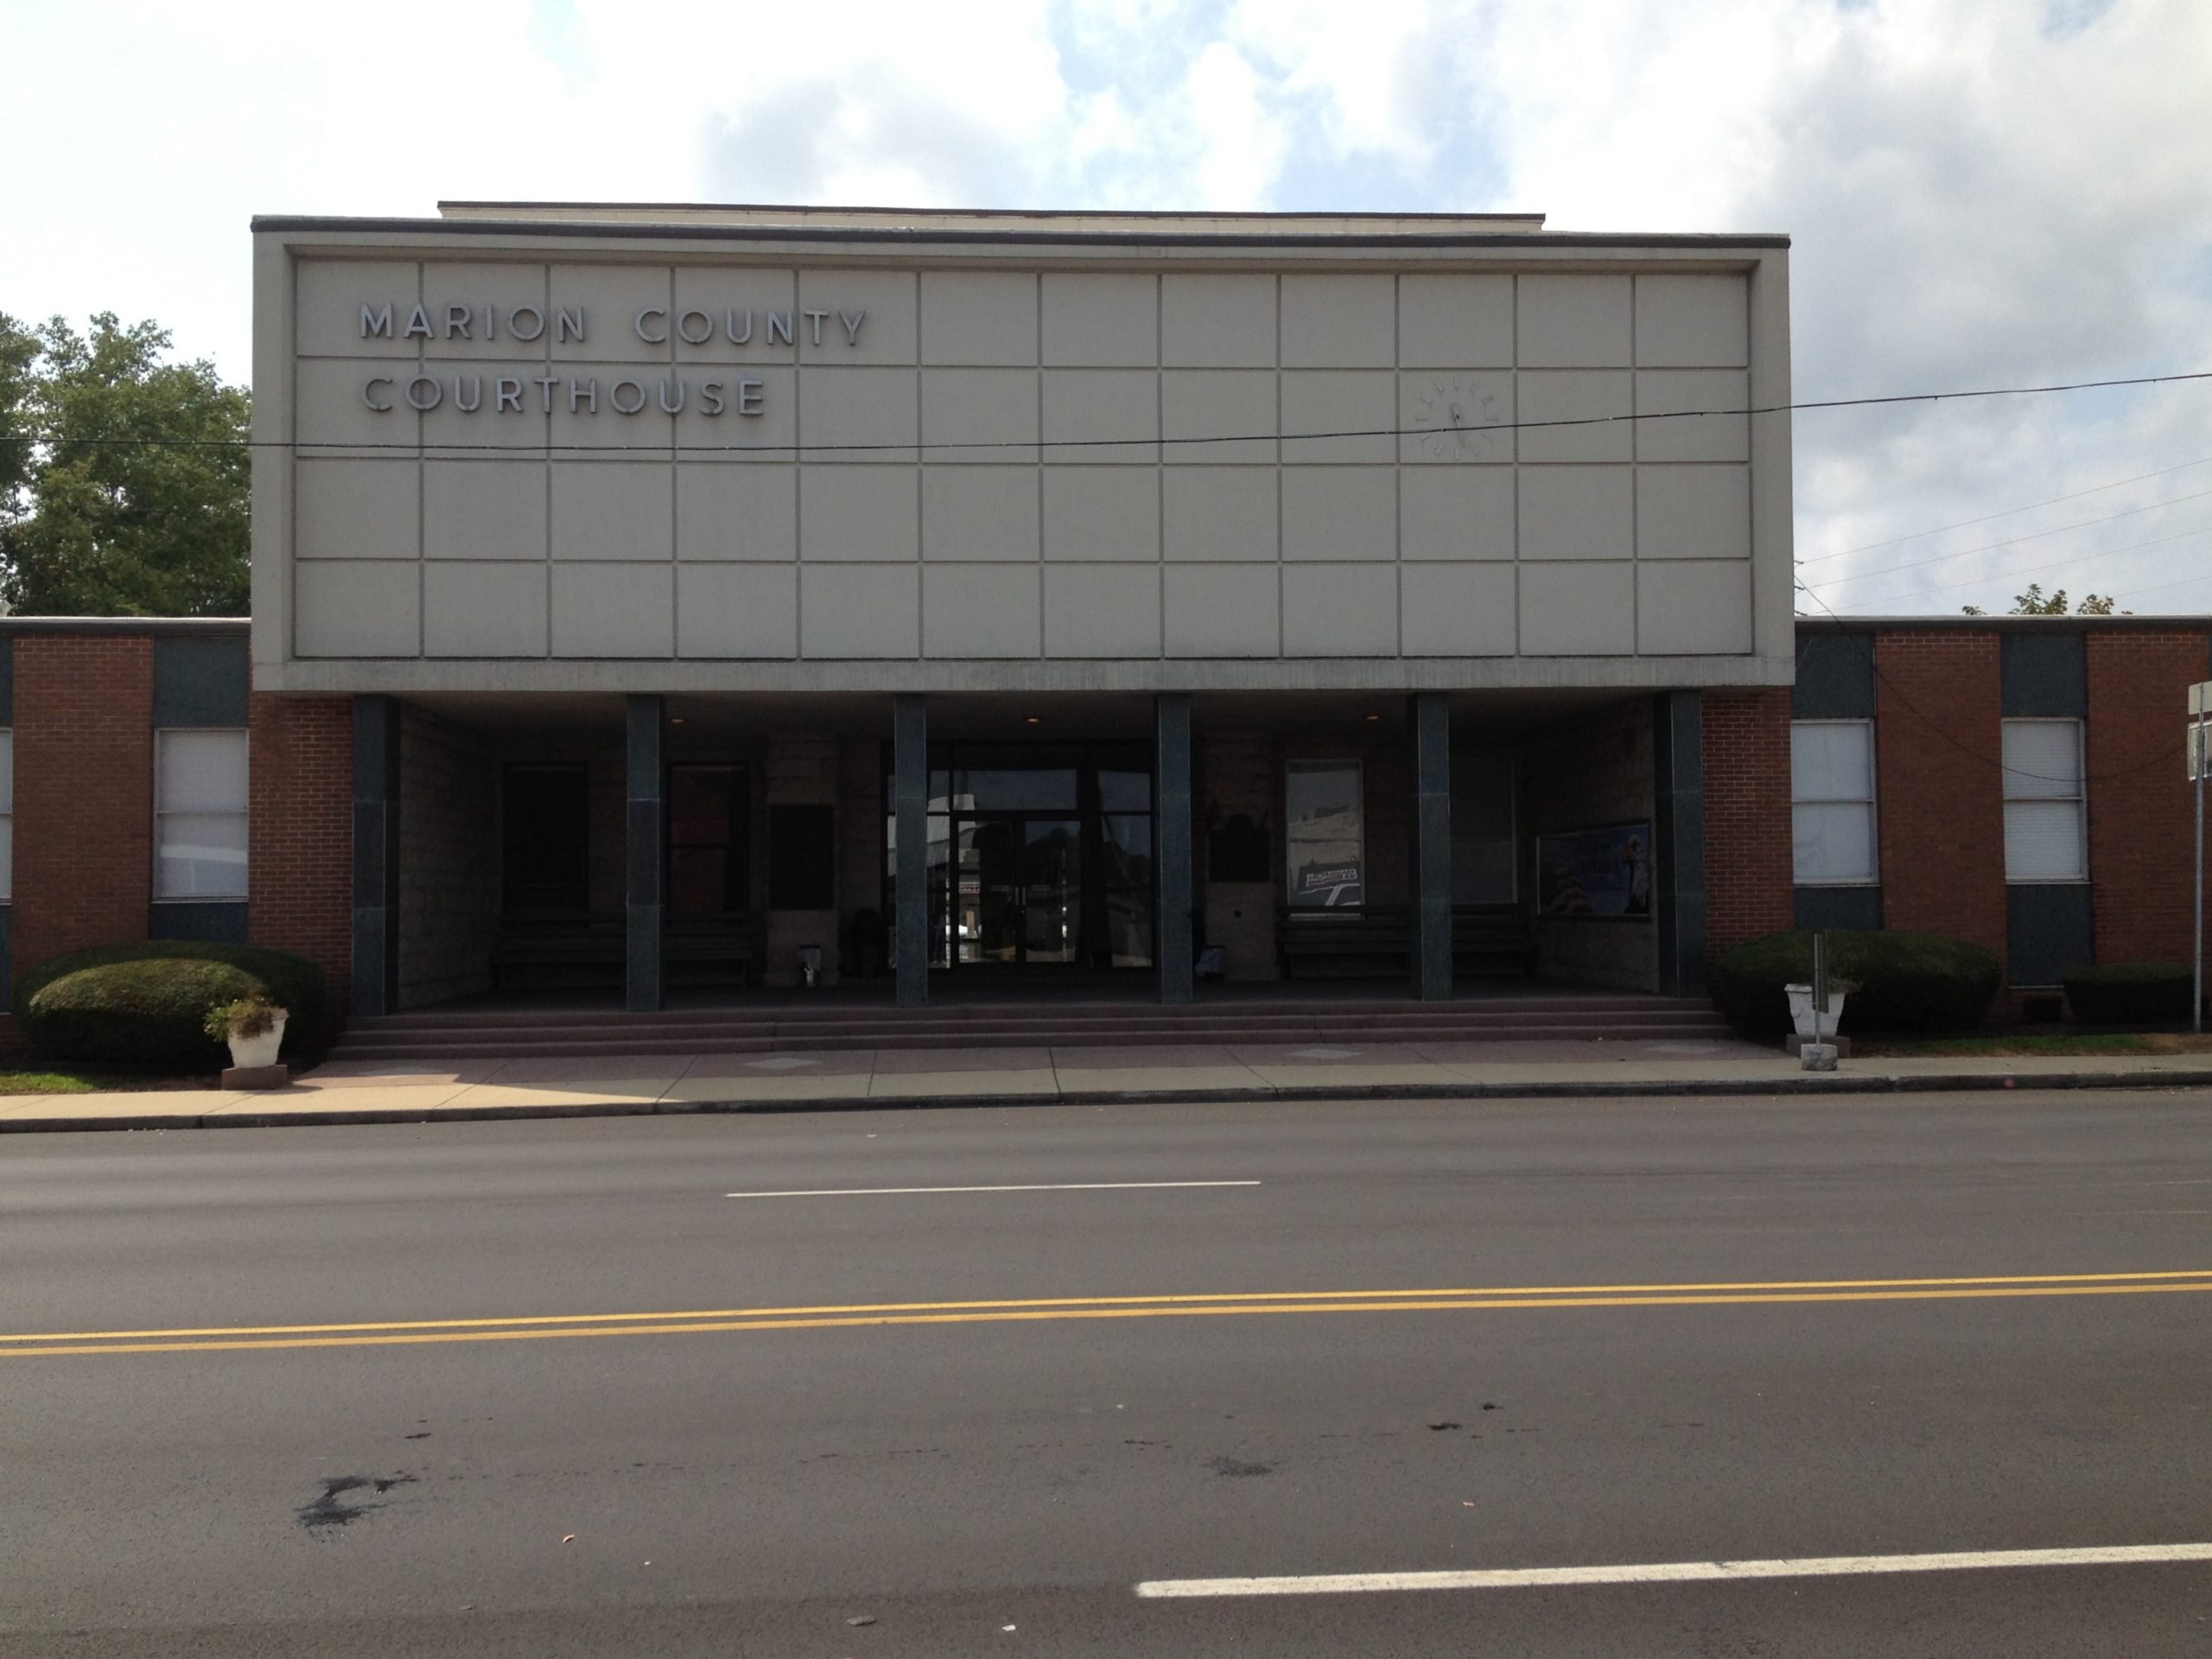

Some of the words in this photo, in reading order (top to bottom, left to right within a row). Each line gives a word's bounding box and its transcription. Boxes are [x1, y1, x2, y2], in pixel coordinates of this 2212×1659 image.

[359, 302, 585, 343] MARION
[635, 306, 868, 346] COUNTY
[361, 376, 766, 416] COURTHOUSE
